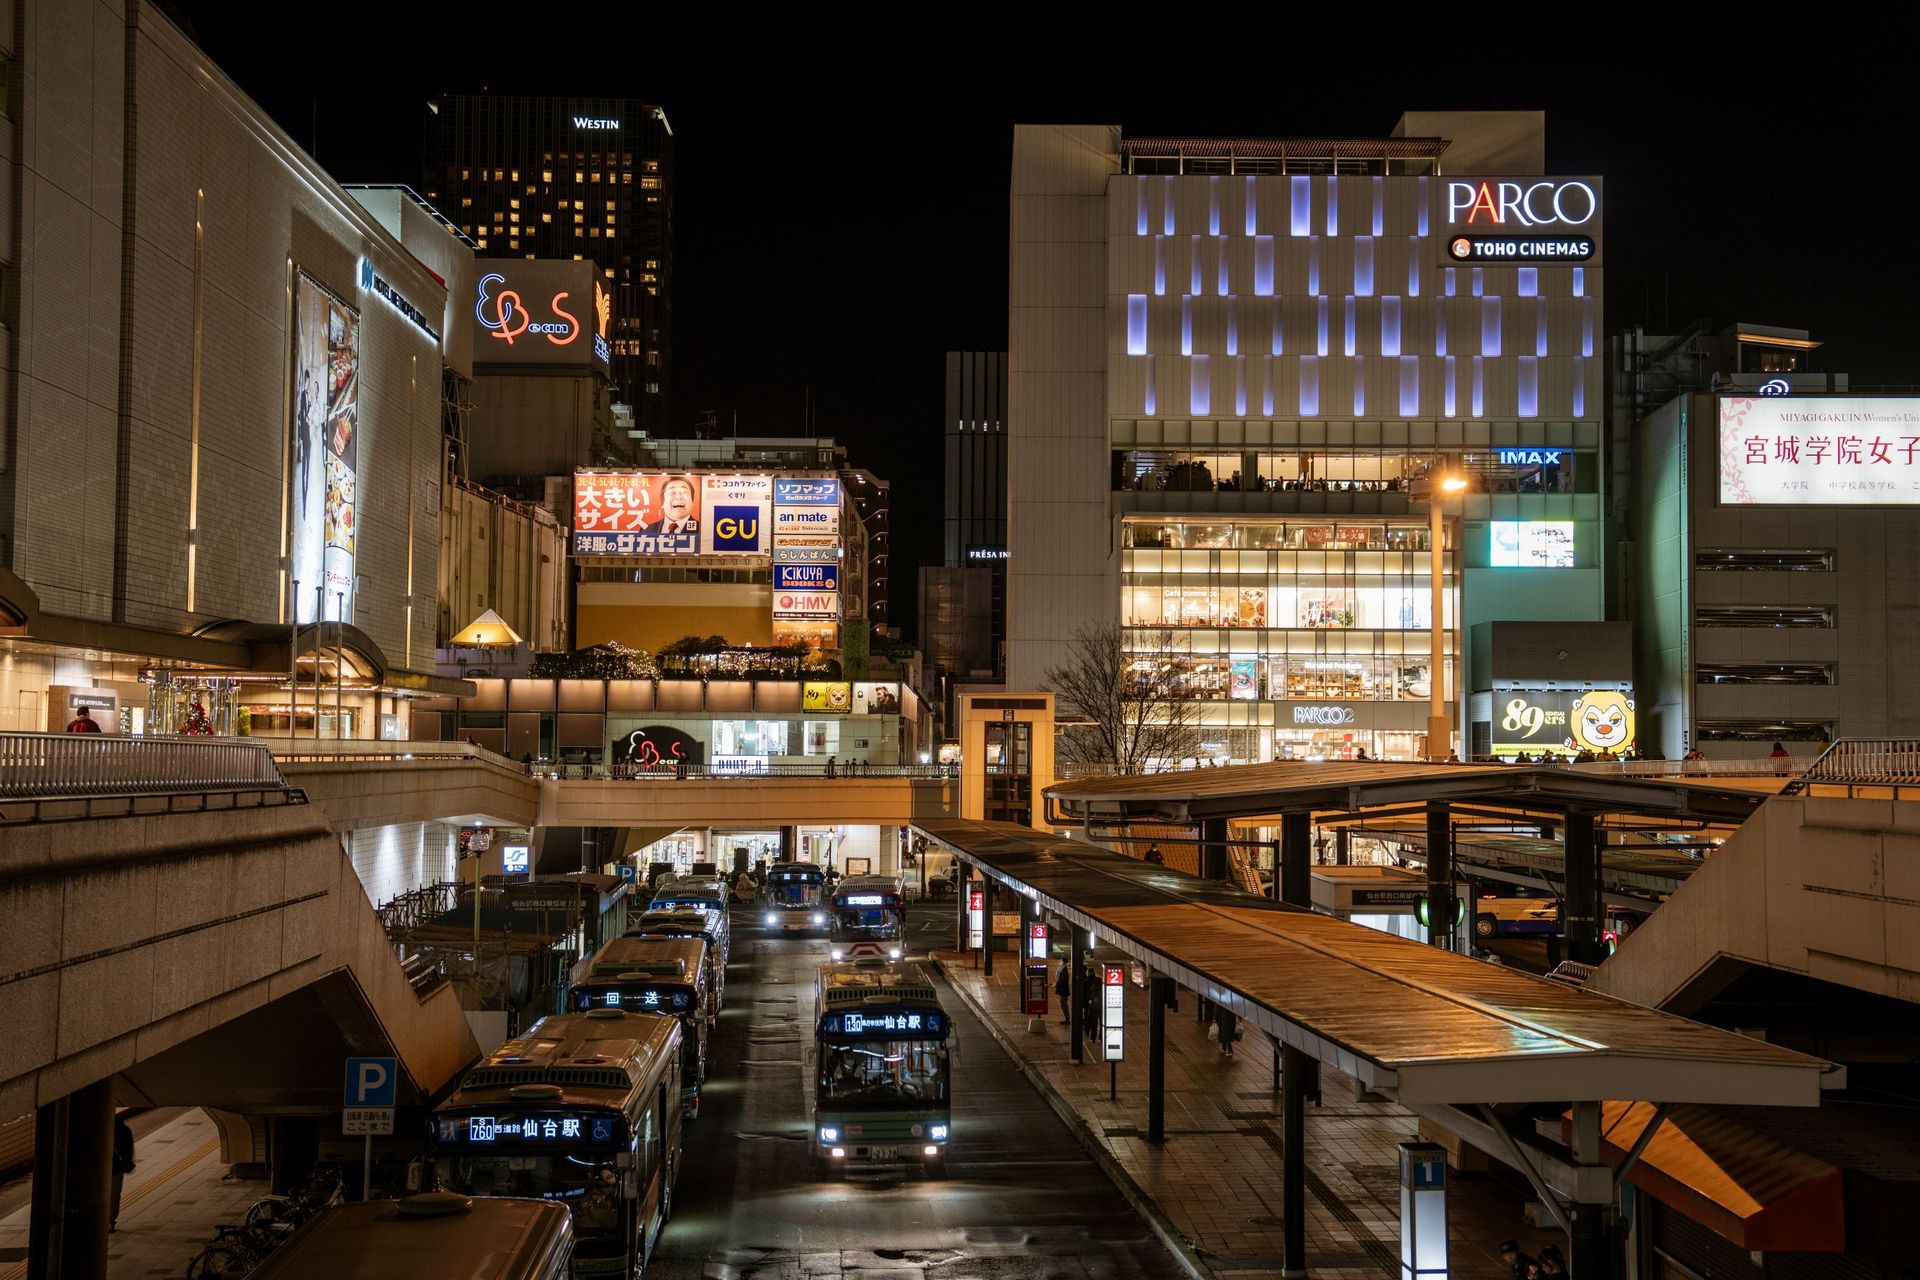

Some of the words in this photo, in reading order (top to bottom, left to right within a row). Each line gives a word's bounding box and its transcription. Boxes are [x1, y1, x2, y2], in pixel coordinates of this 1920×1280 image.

[1449, 181, 1596, 226] PARCO
[1474, 242, 1516, 255] TOHO
[1519, 242, 1589, 255] CINEMAS
[1780, 413, 1817, 423] MIYAGI
[1818, 413, 1861, 423] GAKUIN
[1863, 413, 1902, 423] Women's
[1500, 451, 1560, 464] IMAX
[1744, 435, 1920, 466] 宮城学院女子
[778, 484, 835, 494] ソフマップ
[577, 486, 650, 509] 大きい
[578, 508, 650, 530] サイズ
[686, 521, 696, 530] 3F
[716, 517, 757, 540] GU
[577, 534, 696, 553] 洋服のサカゼン
[794, 597, 831, 610] HMV
[1502, 699, 1545, 739] 89
[622, 867, 633, 880] P
[973, 898, 981, 908] 4
[1036, 927, 1043, 937] 3
[1110, 972, 1119, 983] 2
[884, 1015, 920, 1029] 仙台駅
[358, 1063, 387, 1102] P
[472, 1125, 493, 1140] 760
[523, 1118, 580, 1137] 仙台駅
[1422, 1161, 1432, 1182] 1
